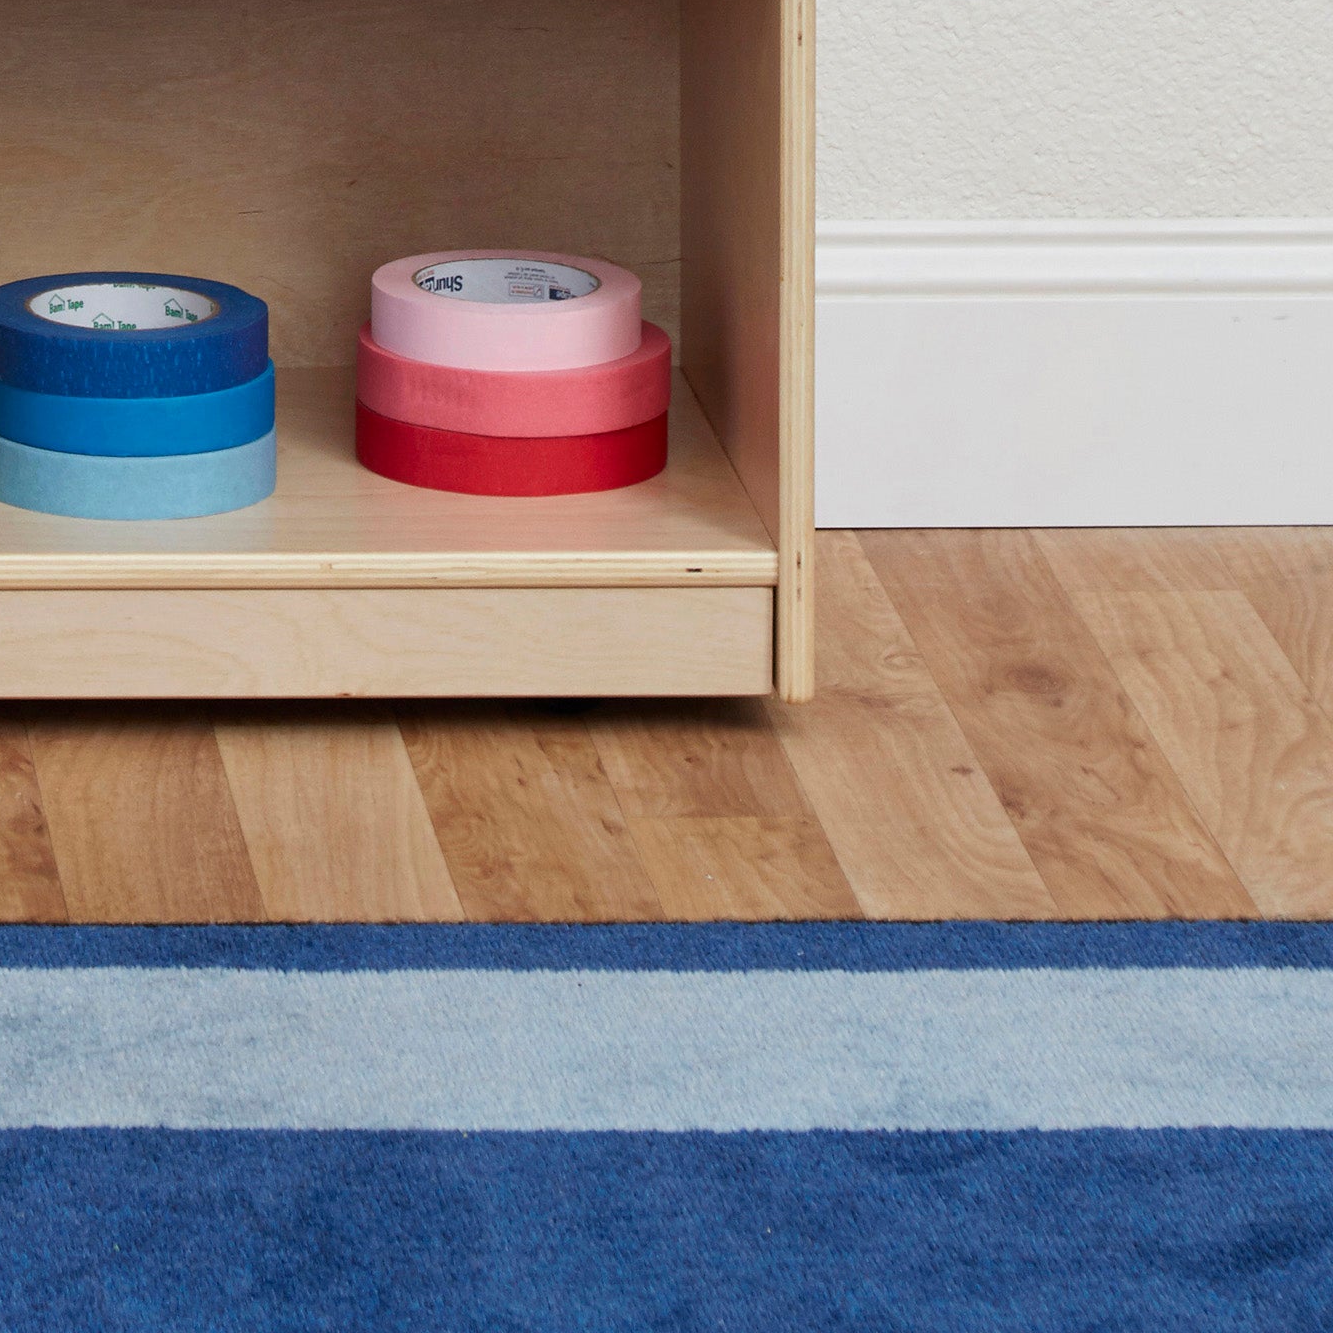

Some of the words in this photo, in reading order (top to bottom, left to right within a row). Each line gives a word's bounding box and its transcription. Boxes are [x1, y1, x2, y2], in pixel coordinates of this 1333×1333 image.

[48, 302, 66, 315] Bam!
[67, 299, 85, 312] Tape
[164, 305, 184, 319] Bam!
